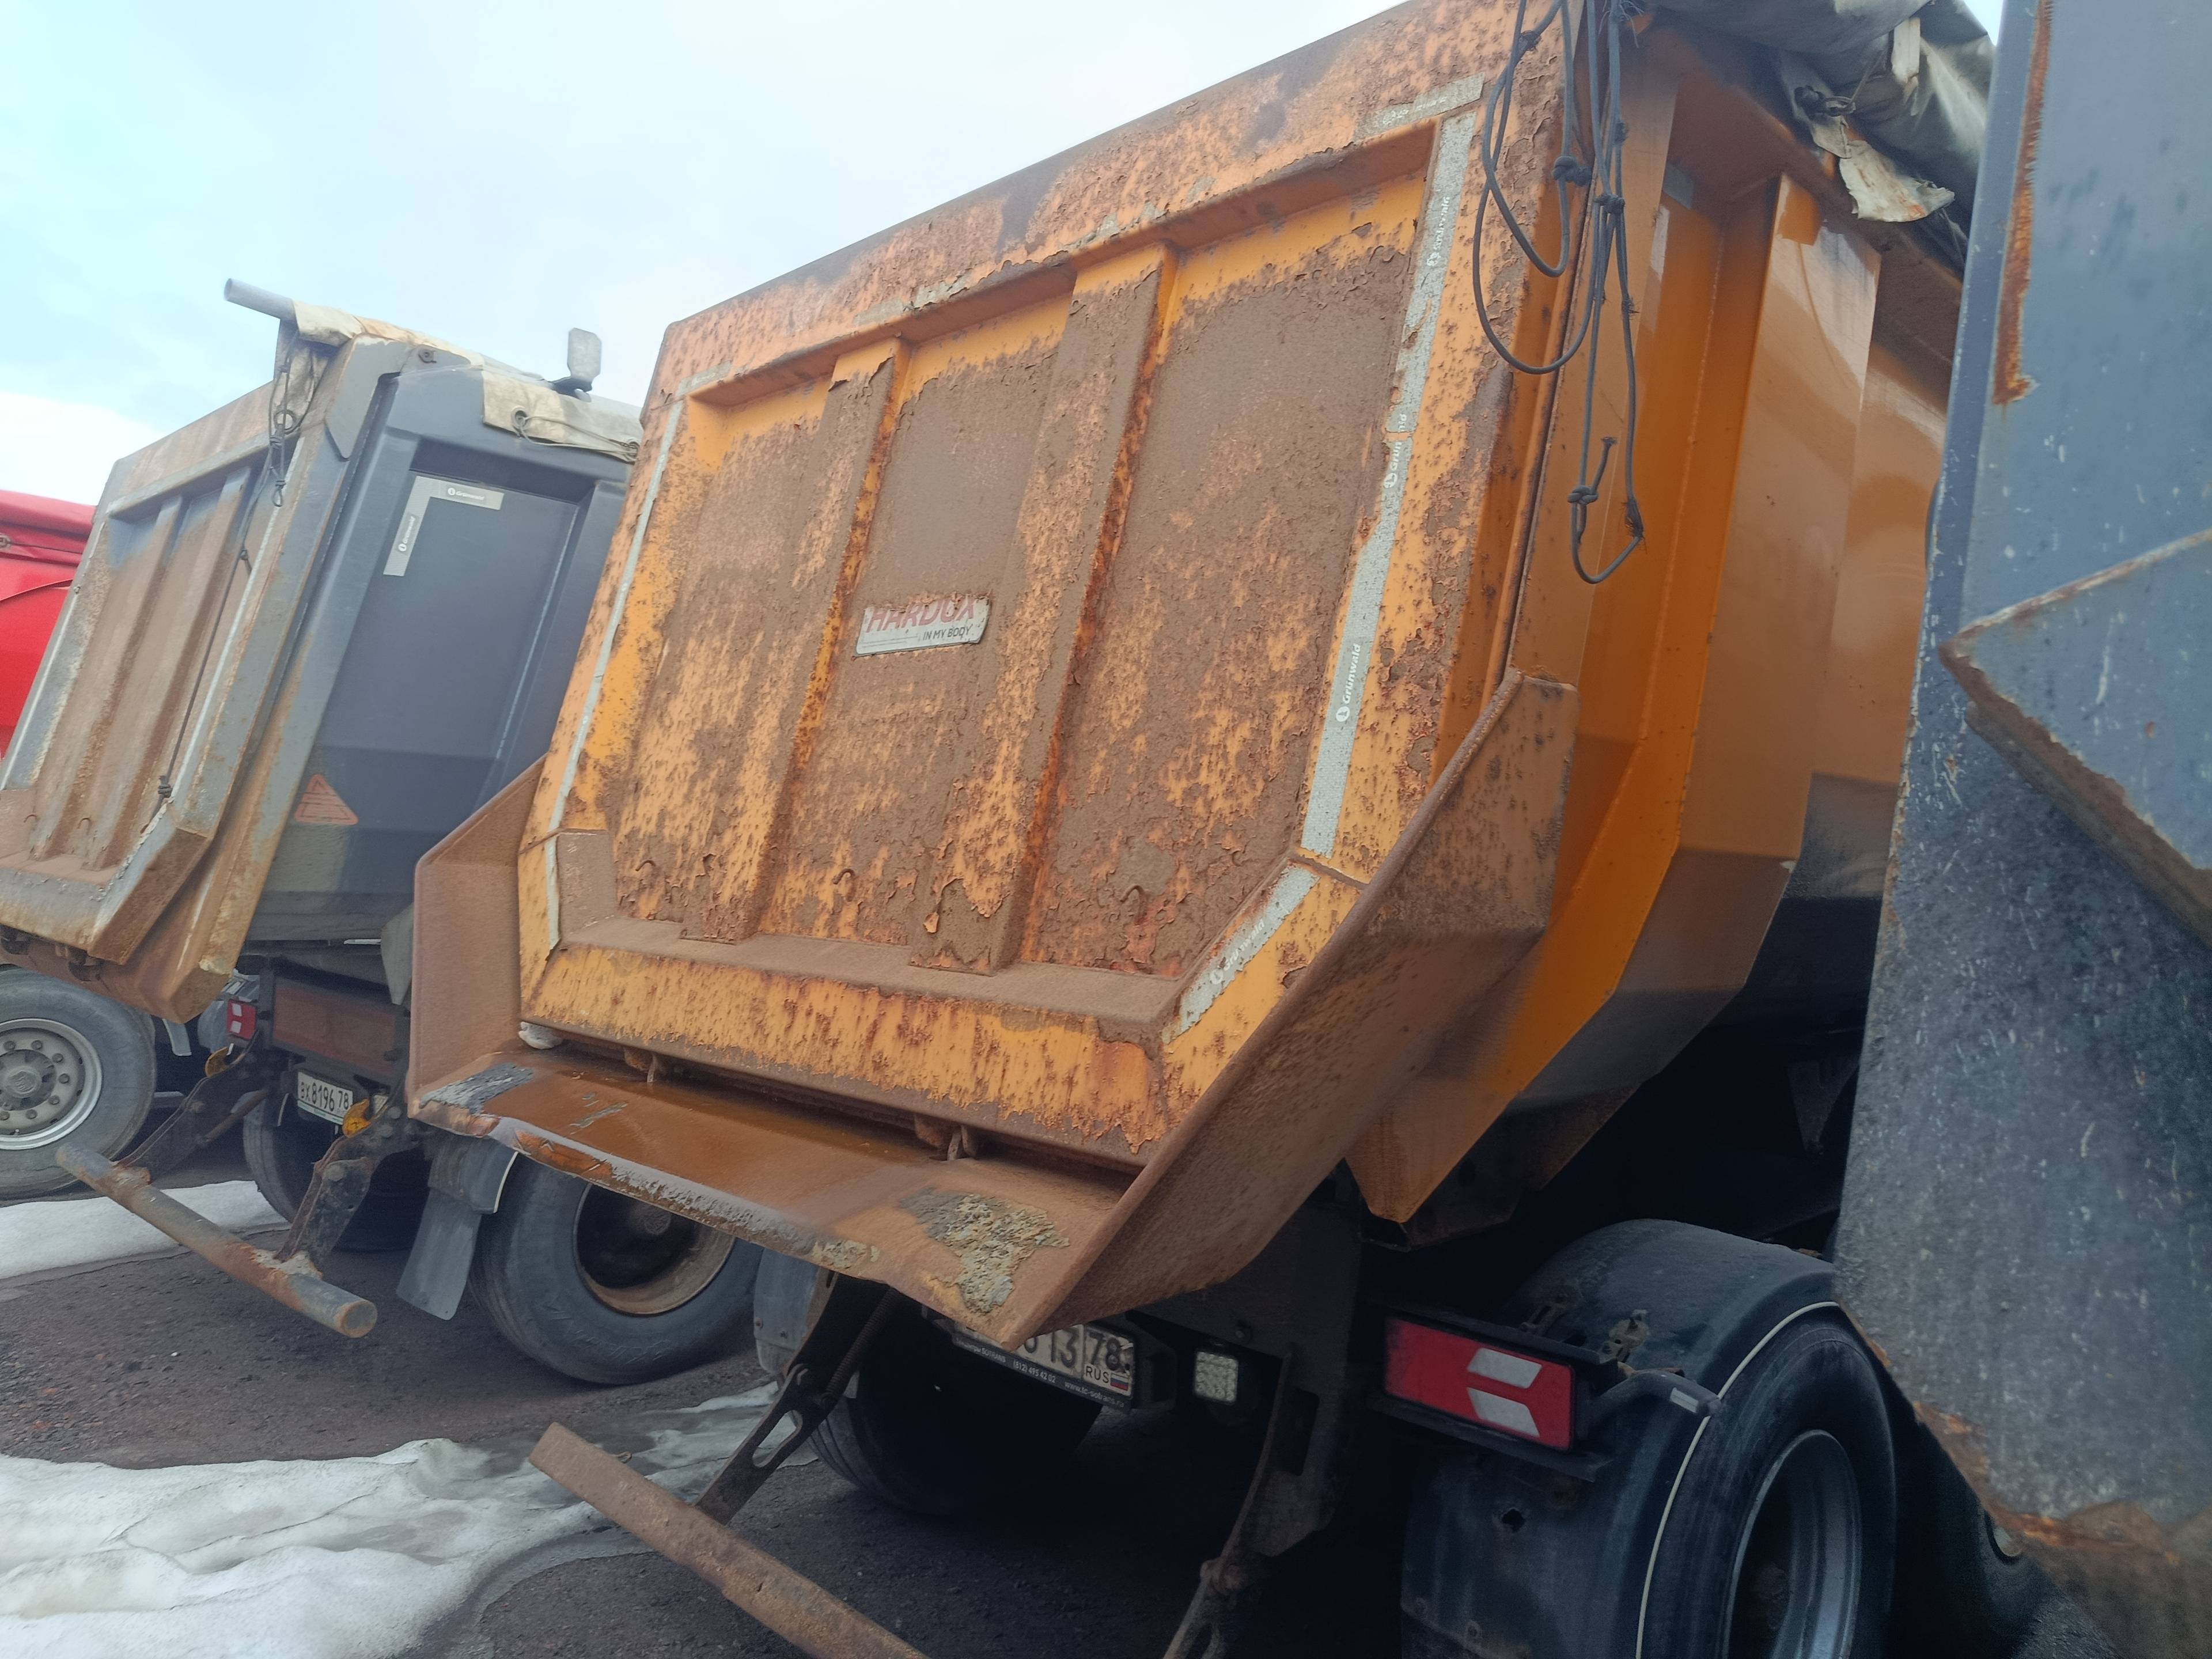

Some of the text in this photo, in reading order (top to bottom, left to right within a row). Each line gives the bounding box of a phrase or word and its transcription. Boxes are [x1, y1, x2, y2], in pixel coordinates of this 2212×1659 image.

[923, 625, 972, 641] IN MY BODY
[1085, 1365, 1110, 1384] RUS
